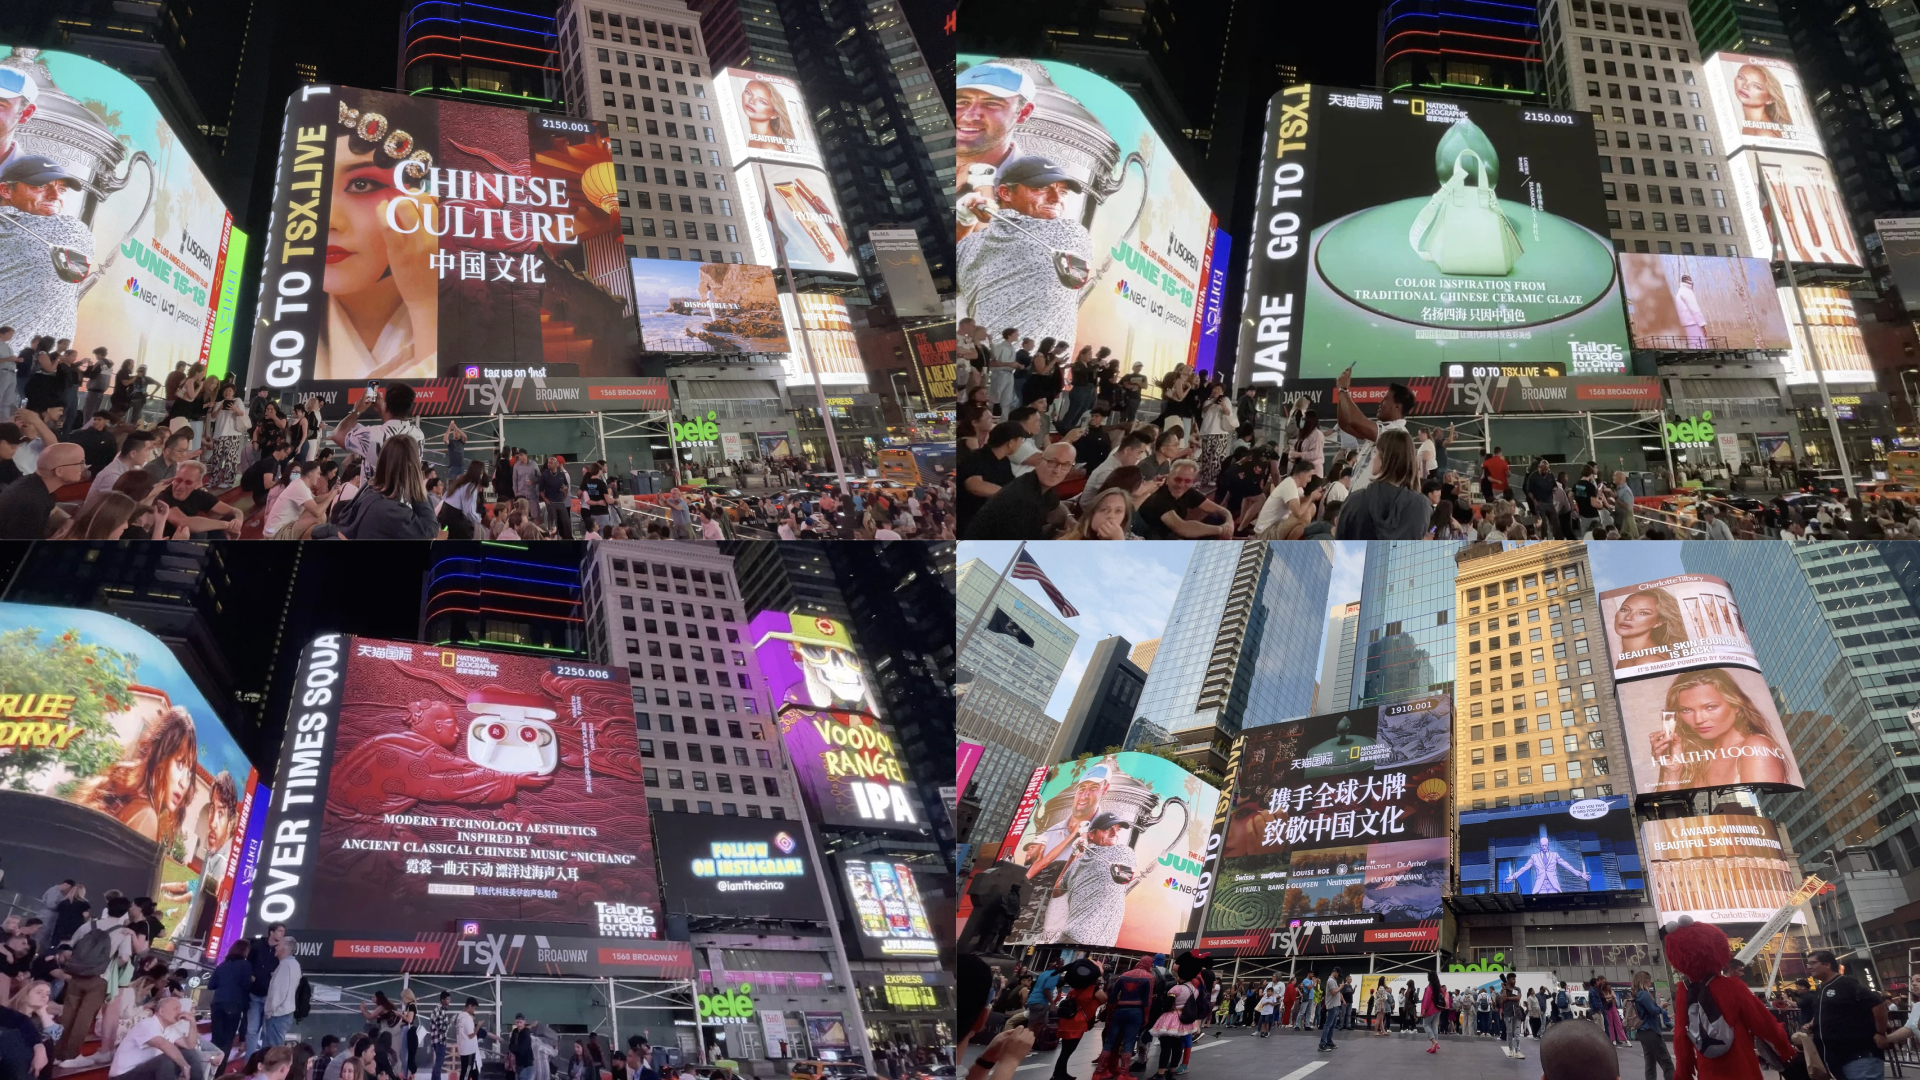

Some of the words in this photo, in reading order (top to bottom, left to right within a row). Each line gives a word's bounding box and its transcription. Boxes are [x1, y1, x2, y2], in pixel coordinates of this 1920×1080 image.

[1328, 93, 1383, 111] 天猫国际
[1425, 102, 1460, 111] NATIONAL
[1425, 108, 1469, 118] GEOGRAPHIC
[1524, 111, 1574, 125] 2150.001
[542, 119, 591, 133] 2150.001
[1742, 120, 1782, 132] BEAUTIFUL
[393, 160, 570, 209] CHINESE
[1271, 162, 1305, 208] TO
[282, 124, 327, 264] TSX.LIVE
[386, 196, 578, 245] CULTURE
[1267, 211, 1301, 260] GO
[120, 237, 172, 285] JUNE
[172, 271, 207, 307] 15-18
[429, 248, 546, 284] 中国文化
[1110, 240, 1160, 287] JUNE
[1161, 273, 1194, 309] 15-18
[1394, 277, 1436, 288] COLOR
[1439, 278, 1512, 290] INSPIRATION
[1514, 281, 1546, 291] FROM
[139, 288, 157, 307] NBC
[274, 271, 312, 321] TO
[1129, 289, 1147, 308] NBC
[1204, 269, 1224, 337] EDITION
[1354, 289, 1437, 301] TRADITIONAL
[1440, 291, 1490, 302] CHINESE
[1492, 293, 1544, 304] CERAMIC
[1546, 294, 1584, 305] GLAZE
[1421, 306, 1467, 322] 名扬四海
[1469, 307, 1526, 322] 只因中国色
[1567, 341, 1622, 352] Tailor-
[266, 330, 305, 388] GO
[1572, 350, 1623, 361] made
[501, 369, 513, 378] us
[514, 369, 527, 378] on
[1472, 366, 1487, 377] GO
[1488, 366, 1500, 377] TO
[1500, 366, 1540, 377] TSX.LIVE
[463, 377, 510, 414] TSX
[536, 387, 580, 401] BROADWAY
[600, 388, 617, 397] 1568
[617, 388, 657, 396] BROADWAY
[1448, 376, 1495, 413] TSX
[1521, 386, 1567, 400] BROADWAY
[1606, 388, 1649, 396] BROADWAY
[680, 440, 714, 448] SOCCER
[1674, 440, 1710, 449] SOCCER
[357, 644, 413, 662] 天猫国际
[1618, 645, 1671, 661] BEAUTIFUL
[1672, 640, 1697, 651] SKIN
[1670, 650, 1680, 659] IS
[1681, 646, 1715, 658] BACK!
[456, 654, 491, 663] NATIONAL
[1650, 662, 1676, 671] MAKEUP
[1677, 657, 1708, 666] POWERED
[456, 661, 499, 672] GEOGRAPHIC
[557, 666, 609, 679] 2250.006
[1390, 701, 1432, 715] 1910.001
[1360, 743, 1386, 752] NATIONAL
[1360, 748, 1392, 757] GEOGRAPHIC
[281, 712, 329, 812] TIMES
[1290, 755, 1334, 771] 天猫国际
[1652, 748, 1717, 767] HEALTHY
[1720, 745, 1785, 760] LOOKING
[1267, 772, 1407, 815] 携手全球大牌
[851, 781, 917, 824] IPA
[383, 813, 438, 827] MODERN
[441, 817, 524, 832] TECHNOLOGY
[526, 823, 598, 837] AESTHETICS
[1192, 871, 1212, 909] GO
[1212, 734, 1245, 831] TSX.LIVE
[1261, 805, 1405, 847] 致敬中国文化
[457, 831, 513, 845] INSPIRED
[515, 835, 532, 845] BY
[1680, 824, 1760, 837] AWARD-WINNING
[341, 838, 400, 852] ANCIENT
[403, 842, 472, 856] CLASSICAL
[475, 846, 528, 859] CHINESE
[530, 849, 569, 861] MUSIC
[711, 841, 769, 859] FOLLOW
[1654, 838, 1708, 851] BEAUTIFUL
[1709, 837, 1733, 848] SKIN
[227, 845, 241, 880] STORE
[241, 838, 259, 886] EDITION
[1187, 850, 1198, 860] THE
[260, 818, 311, 923] OVER
[405, 858, 494, 878] 霓裳一曲天下动
[495, 862, 580, 882] 漂洋过海声入耳
[691, 858, 716, 877] ON
[715, 858, 804, 876] INSTAGRAM!
[1234, 873, 1256, 882] Swisse
[1292, 869, 1315, 877] LOUISE
[1354, 863, 1391, 871] HAMILTON
[717, 880, 784, 892] @iamthecinco
[1267, 883, 1285, 891] BANG
[1290, 881, 1319, 889] OLUFSEN
[594, 901, 654, 915] Tailor-
[599, 913, 655, 926] made
[1269, 926, 1302, 956] TSX
[1320, 932, 1357, 945] BROADWAY
[1389, 930, 1427, 939] BROADWAY
[349, 944, 371, 953] 1568
[372, 945, 426, 954] BROADWAY
[457, 933, 508, 975] TSX
[538, 948, 588, 963] BROADWAY
[612, 952, 631, 961] 1568
[632, 953, 679, 962] BROADWAY
[884, 974, 923, 984] EXPRESS
[708, 1016, 748, 1025] SOCCER
